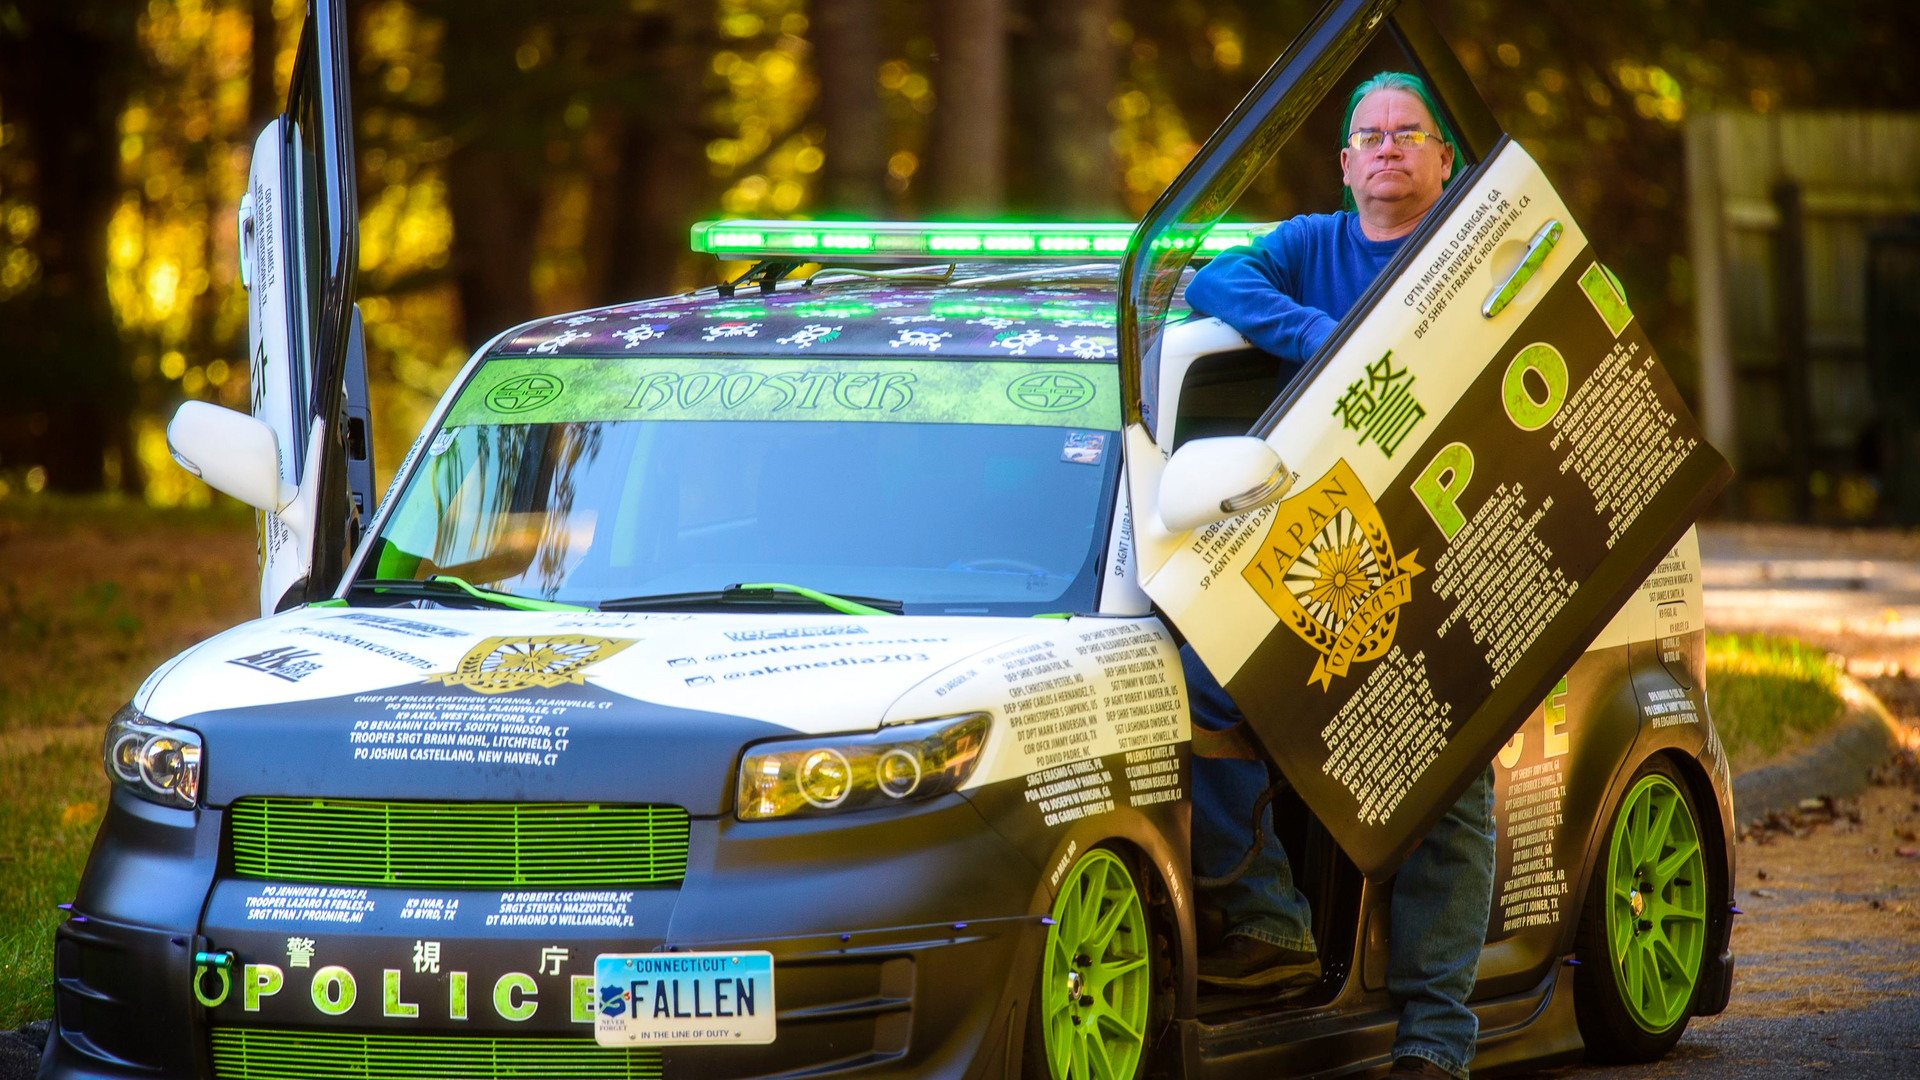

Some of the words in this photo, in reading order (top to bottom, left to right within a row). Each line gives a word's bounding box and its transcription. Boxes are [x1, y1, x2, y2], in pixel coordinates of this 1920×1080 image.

[265, 220, 273, 245] VICKY
[1404, 283, 1425, 306] CPTN
[1421, 249, 1454, 285] MICHAEL
[1450, 241, 1459, 249] D
[1456, 203, 1492, 241] GARIGAN,
[1488, 189, 1501, 202] GA
[1416, 301, 1427, 314] LT
[1425, 280, 1445, 305] JUAN
[1442, 274, 1451, 283] R
[1447, 215, 1501, 276] RIVERA-PADUA,
[1497, 200, 1510, 214] PR
[1414, 320, 1429, 339] DEP
[1428, 297, 1447, 322] SHRF
[1451, 262, 1476, 293] FRANK
[1474, 255, 1482, 264] G
[1479, 219, 1511, 258] HOLGUIN
[1519, 195, 1531, 208] CA
[267, 274, 275, 287] TX
[624, 371, 917, 413] ROOSTER
[1551, 411, 1567, 429] COR
[1565, 404, 1572, 414] O
[1569, 376, 1594, 408] WITNEY
[1593, 353, 1616, 380] CLOUD,
[1614, 343, 1624, 355] FL
[1332, 349, 1426, 459] 警
[1256, 474, 1349, 591] JAPAN
[1118, 541, 1129, 566] AGNT
[1191, 540, 1204, 554] LT
[1200, 575, 1211, 590] SP
[1210, 553, 1232, 579] AGNT
[1228, 527, 1256, 556] WAYNE
[1252, 518, 1261, 530] D
[1202, 550, 1215, 565] LT
[1211, 527, 1238, 555] FRANK
[1114, 564, 1124, 578] SP
[1465, 598, 1482, 622] SRGT
[1481, 566, 1509, 603] STEPHEN
[1508, 544, 1530, 571] JONES,
[1528, 532, 1538, 546] SC
[705, 637, 950, 662] @outkastrooster
[723, 653, 930, 680] @akmedia203
[1003, 701, 1017, 714] DEP
[1032, 693, 1054, 708] CARLOS
[1052, 692, 1058, 703] A
[1057, 686, 1090, 703] HERNANDEZ,
[1088, 684, 1096, 695] FL
[1321, 715, 1340, 741] SRGT
[1339, 688, 1363, 720] SONNY
[1362, 684, 1369, 692] L
[1368, 661, 1389, 686] OBIN,
[1387, 645, 1401, 663] MO
[384, 696, 398, 704] OF
[398, 696, 437, 704] POLICE
[436, 696, 487, 705] MATTHEW
[487, 697, 532, 706] CATANIA,
[535, 699, 595, 710] PLAINVILLE,
[435, 704, 486, 713] CYBULSKI,
[487, 704, 550, 716] PLAINVILLE,
[552, 707, 567, 715] CT
[410, 712, 437, 720] AXEL,
[443, 712, 468, 720] WEST
[468, 713, 525, 724] HARTFORD,
[528, 715, 543, 724] CT
[354, 721, 369, 730] PO
[370, 721, 422, 730] BENJAMIN
[421, 721, 462, 732] LOVETT,
[464, 722, 499, 732] SOUTH
[500, 724, 552, 738] WINDSOR,
[555, 726, 569, 737] CT
[350, 732, 395, 743] TROOPER
[396, 733, 423, 744] SRGT
[423, 733, 456, 745] BRIAN
[457, 734, 490, 748] MOHL,
[493, 736, 552, 752] LITCHFIELD,
[555, 739, 569, 751] CT
[354, 748, 370, 759] PO
[369, 748, 407, 760] JOSHUA
[410, 749, 475, 763] CASTELLANO,
[478, 750, 502, 762] NEW
[504, 751, 542, 766] HAVEN,
[544, 754, 558, 765] CT
[1050, 870, 1060, 887] K9
[262, 886, 276, 896] PO
[274, 887, 319, 900] JENNIFER
[318, 888, 327, 899] B
[500, 893, 515, 904] PO
[516, 893, 555, 904] ROBERT
[554, 892, 564, 904] C
[1543, 884, 1560, 896] NEAU,
[1561, 883, 1568, 893] FL
[246, 897, 286, 907] TROOPER
[285, 898, 322, 908] LAZARO
[321, 899, 330, 909] R
[406, 898, 419, 909] K9
[418, 899, 448, 912] IVAR,
[448, 899, 458, 909] LA
[499, 903, 525, 913] SRGT
[524, 903, 562, 913] STEVEN
[248, 909, 273, 920] SRGT
[271, 909, 296, 920] RYAN
[295, 909, 303, 920] J
[400, 908, 414, 918] K9
[414, 908, 442, 921] BYRD,
[444, 910, 456, 920] TX
[486, 915, 500, 925] DT
[498, 915, 548, 925] RAYMOND
[550, 915, 557, 925] O
[636, 958, 727, 973] CONNECTICUT
[243, 963, 596, 1023] POLICE
[630, 978, 755, 1019] FALLEN
[653, 1031, 669, 1039] THE
[692, 1030, 704, 1038] OF
